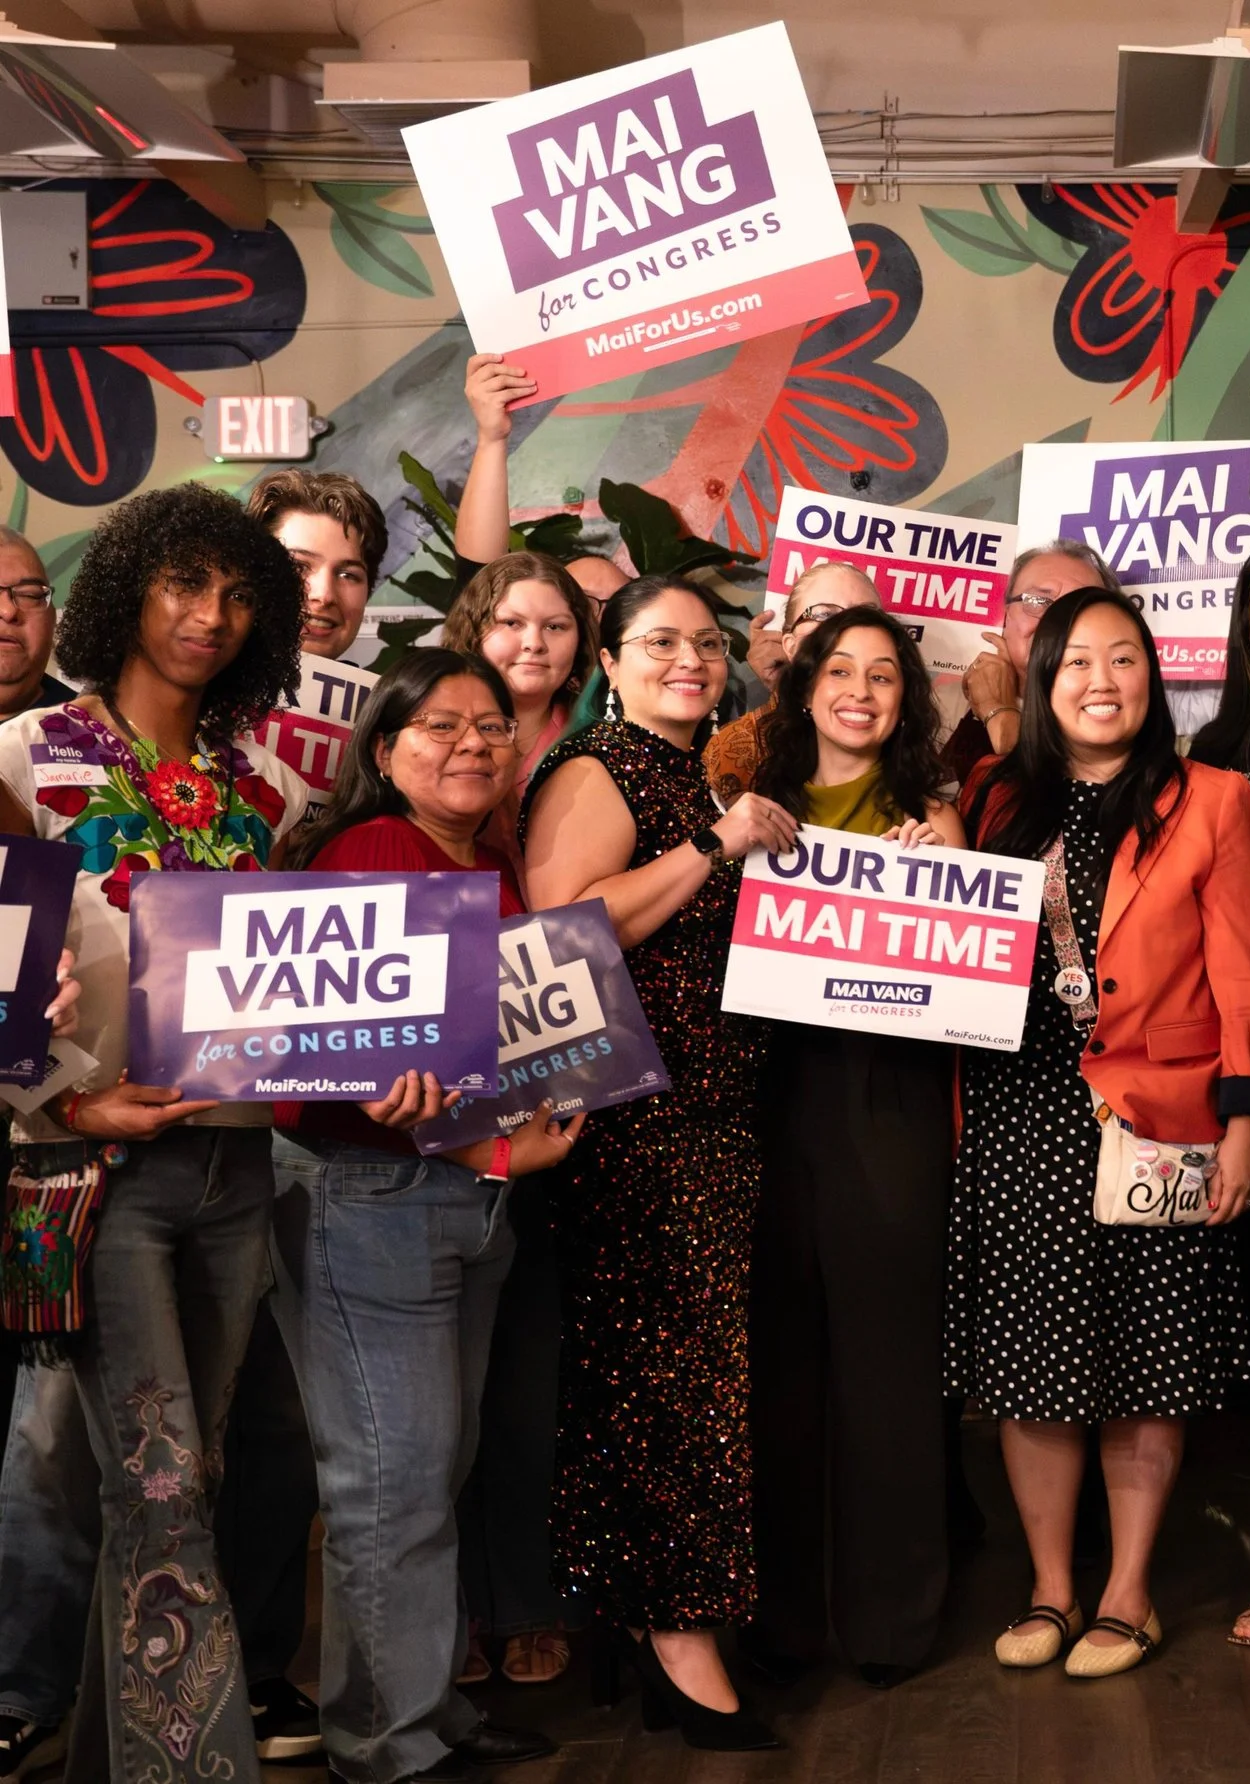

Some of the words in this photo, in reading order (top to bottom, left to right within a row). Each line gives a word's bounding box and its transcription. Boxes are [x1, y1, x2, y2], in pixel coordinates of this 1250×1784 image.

[536, 95, 683, 197] MAI
[523, 143, 737, 259] VANG
[538, 291, 577, 332] for
[582, 211, 782, 300] CONGRESS
[585, 292, 763, 357] MaiForUs.com
[219, 396, 294, 454] EXIT
[1109, 463, 1230, 521] MAI
[796, 504, 896, 553] OUR
[905, 522, 1002, 567] TIME
[886, 568, 993, 616] TIME
[48, 745, 83, 758] Hello
[768, 841, 885, 893] OUR
[897, 856, 1023, 912] TIME
[246, 902, 377, 958] MAI
[754, 893, 865, 950] MAI
[878, 912, 1016, 972] TIME
[216, 953, 411, 1013] VANG
[831, 982, 868, 998] MAI
[872, 985, 923, 1002] VANG
[1061, 984, 1082, 997] 40
[1063, 972, 1083, 983] YES
[828, 1002, 847, 1016] for
[850, 1004, 923, 1017] CONGRESS
[945, 1028, 1014, 1046] MaiForUs.com
[196, 1035, 237, 1072] for
[243, 1023, 441, 1057] CONGRESS
[255, 1078, 377, 1093] MaiForUs.com
